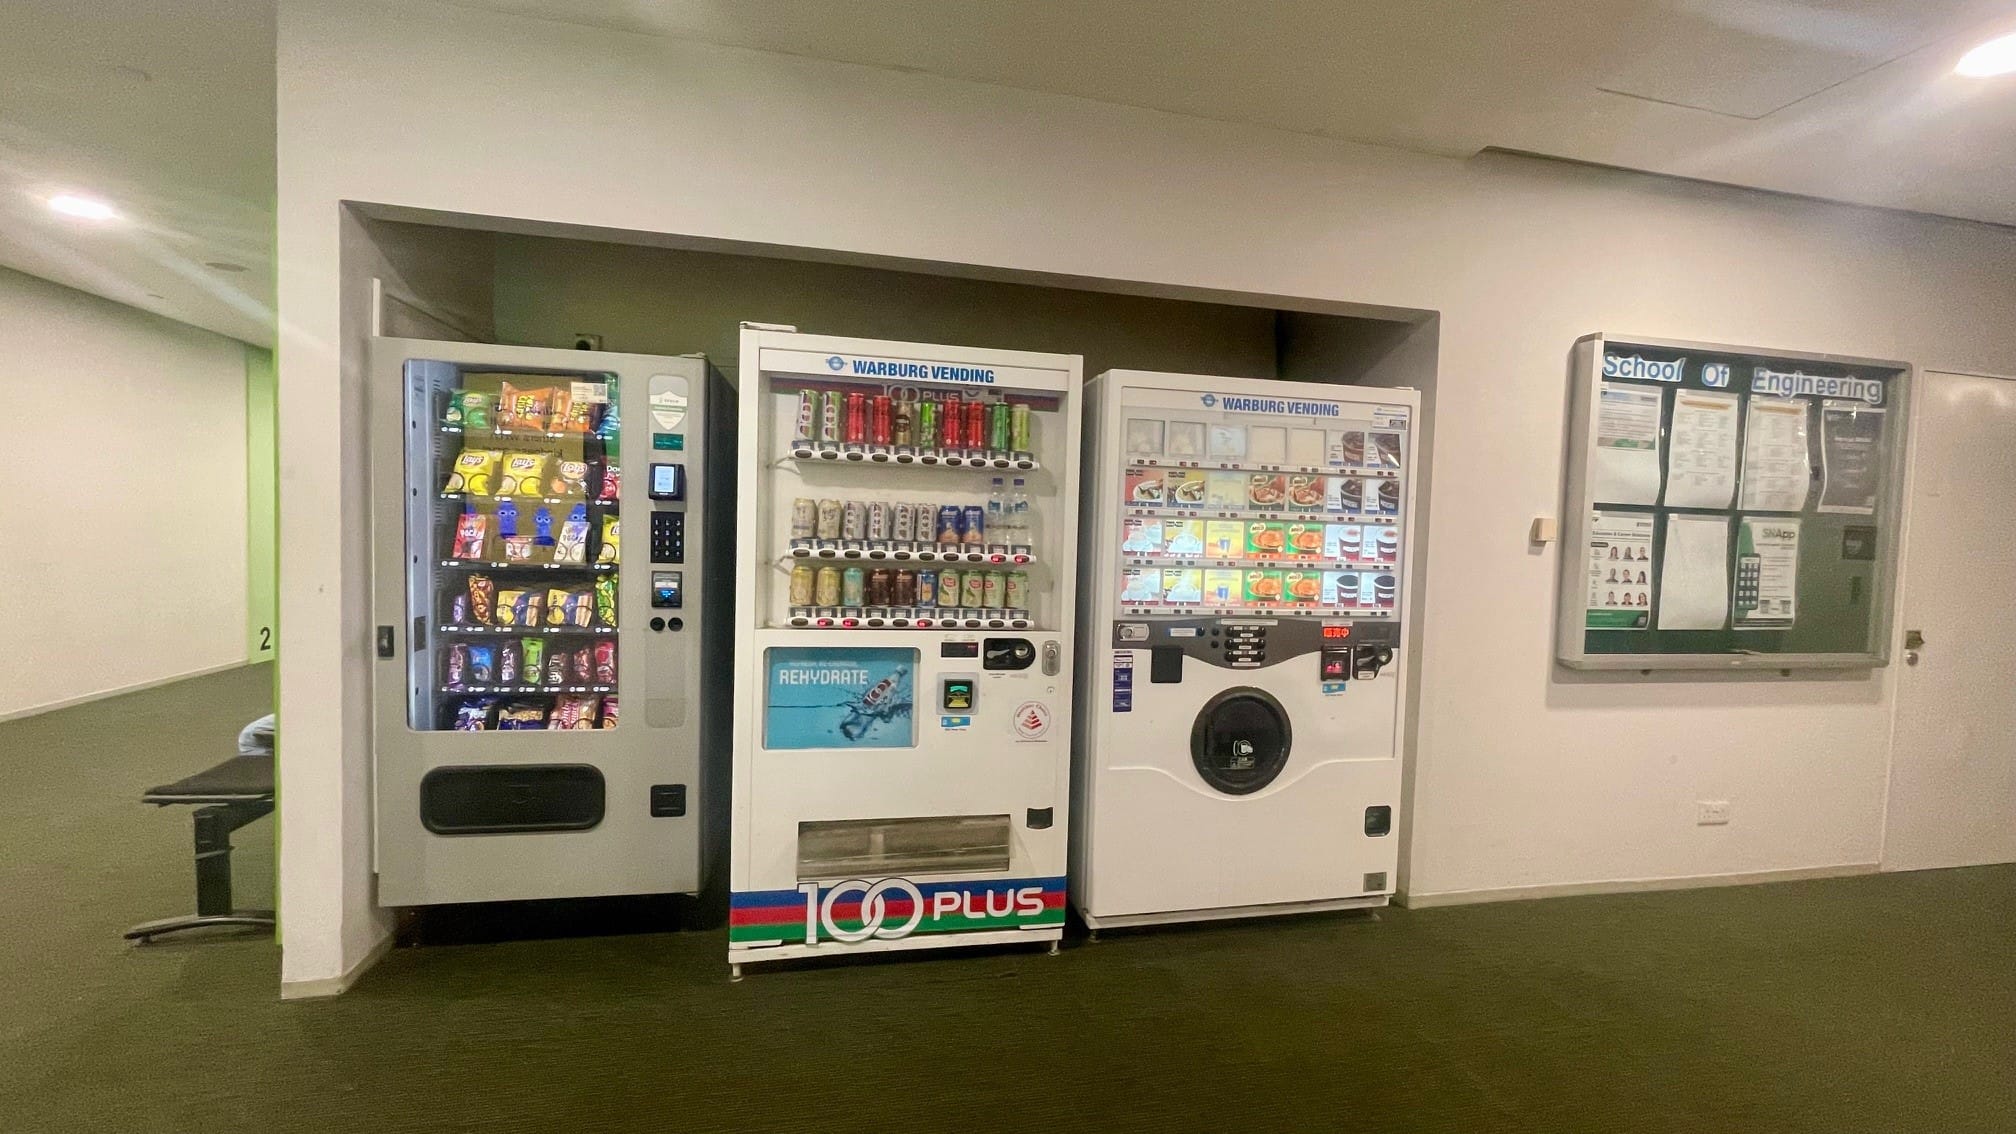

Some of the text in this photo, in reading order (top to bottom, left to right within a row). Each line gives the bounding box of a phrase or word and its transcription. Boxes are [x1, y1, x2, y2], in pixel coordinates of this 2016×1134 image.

[852, 360, 995, 383] WARBURG VENDING
[1602, 352, 1882, 403] School Of Engineering
[1222, 397, 1339, 416] WARBURG VENDING
[260, 626, 271, 651] 2
[779, 669, 869, 685] REHYDRATE
[796, 877, 1044, 946] 100 PLUS
